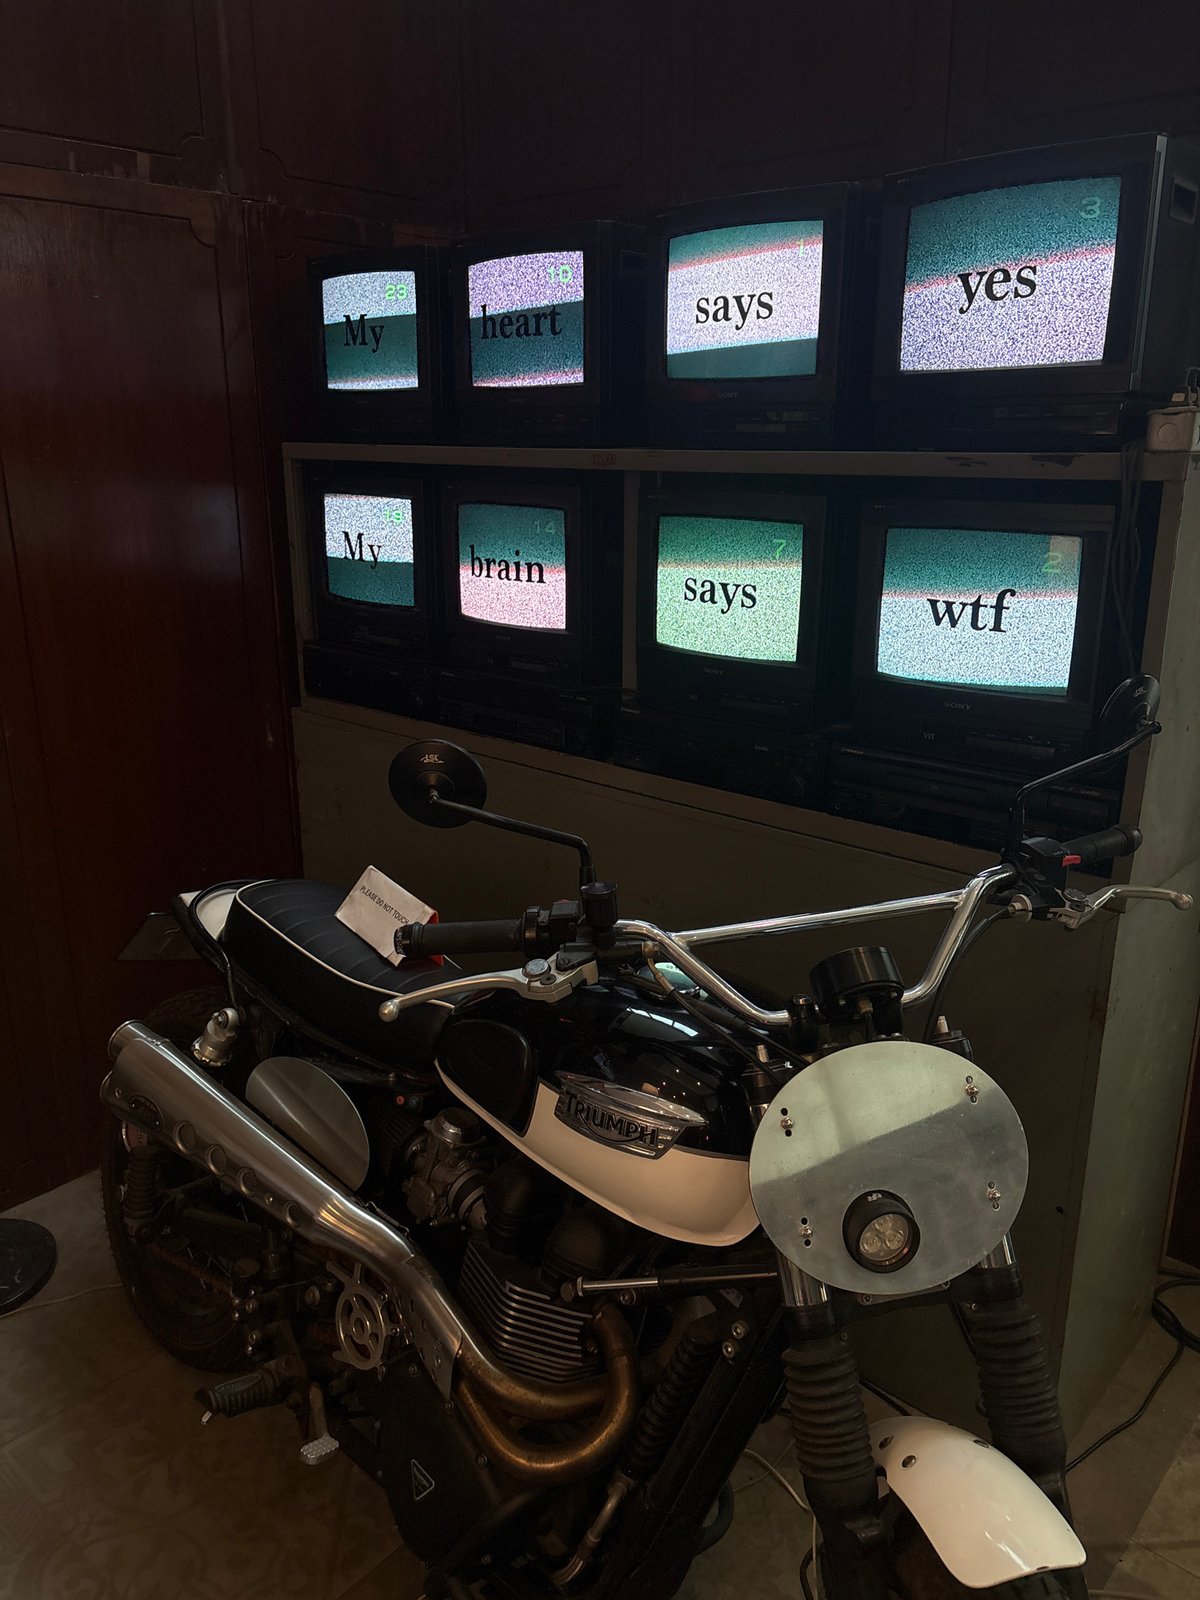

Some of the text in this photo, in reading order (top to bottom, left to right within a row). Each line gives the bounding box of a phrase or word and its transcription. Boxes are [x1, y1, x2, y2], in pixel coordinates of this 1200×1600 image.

[1079, 196, 1101, 218] 3
[385, 284, 408, 300] 23
[547, 265, 573, 283] 10
[957, 263, 1038, 314] yes
[481, 304, 563, 340] heart
[695, 290, 774, 330] says
[343, 313, 385, 353] My
[342, 531, 382, 569] My
[470, 544, 547, 584] brain
[772, 539, 787, 560] 7
[1042, 552, 1062, 572] 2
[684, 576, 757, 614] says
[926, 588, 1016, 633] wtf
[360, 885, 410, 925] PLEASE DO NOT TOUCH
[564, 1090, 658, 1145] TRIUMPH
